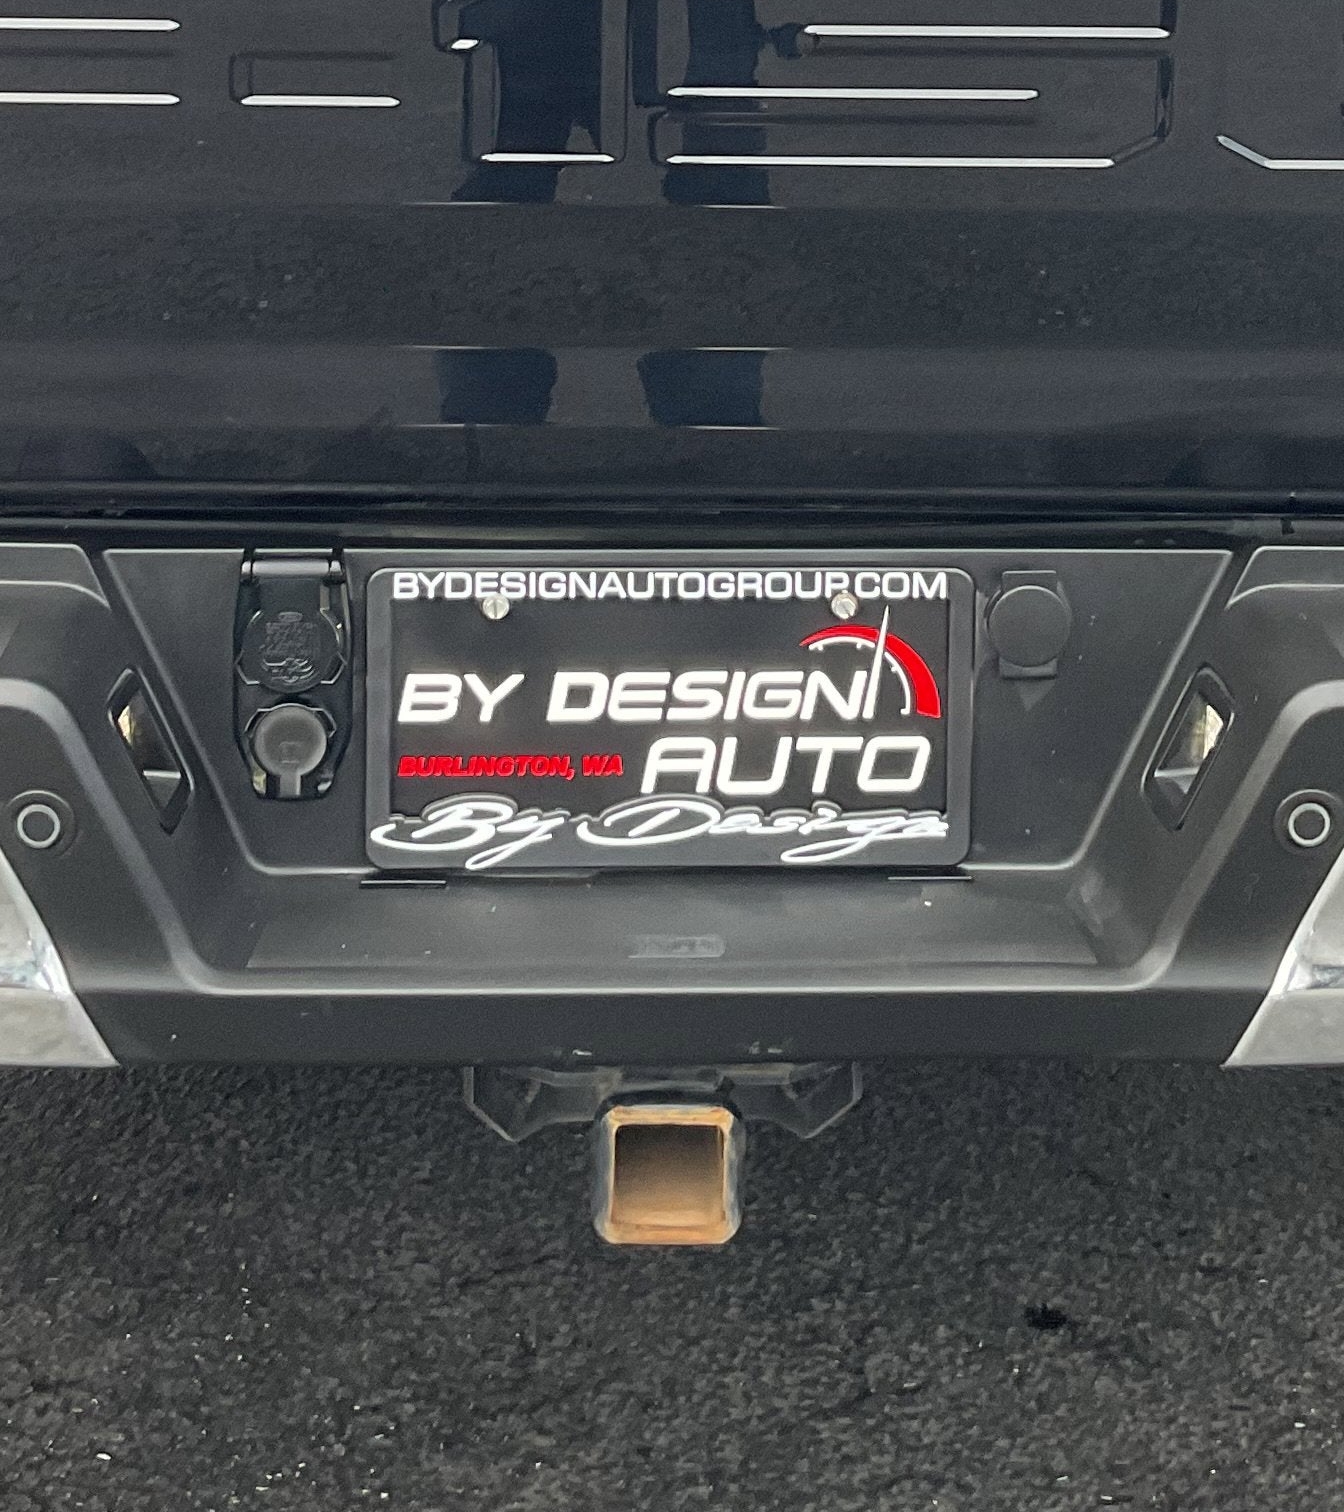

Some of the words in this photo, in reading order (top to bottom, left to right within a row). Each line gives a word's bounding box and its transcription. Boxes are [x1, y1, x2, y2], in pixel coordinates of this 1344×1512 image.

[397, 673, 526, 723] BY
[546, 670, 868, 722] DESIGN
[398, 755, 575, 780] BURLINGTON,
[582, 754, 623, 777] WA
[640, 735, 931, 796] AUTO
[370, 800, 565, 871] By
[576, 799, 949, 863] Design
